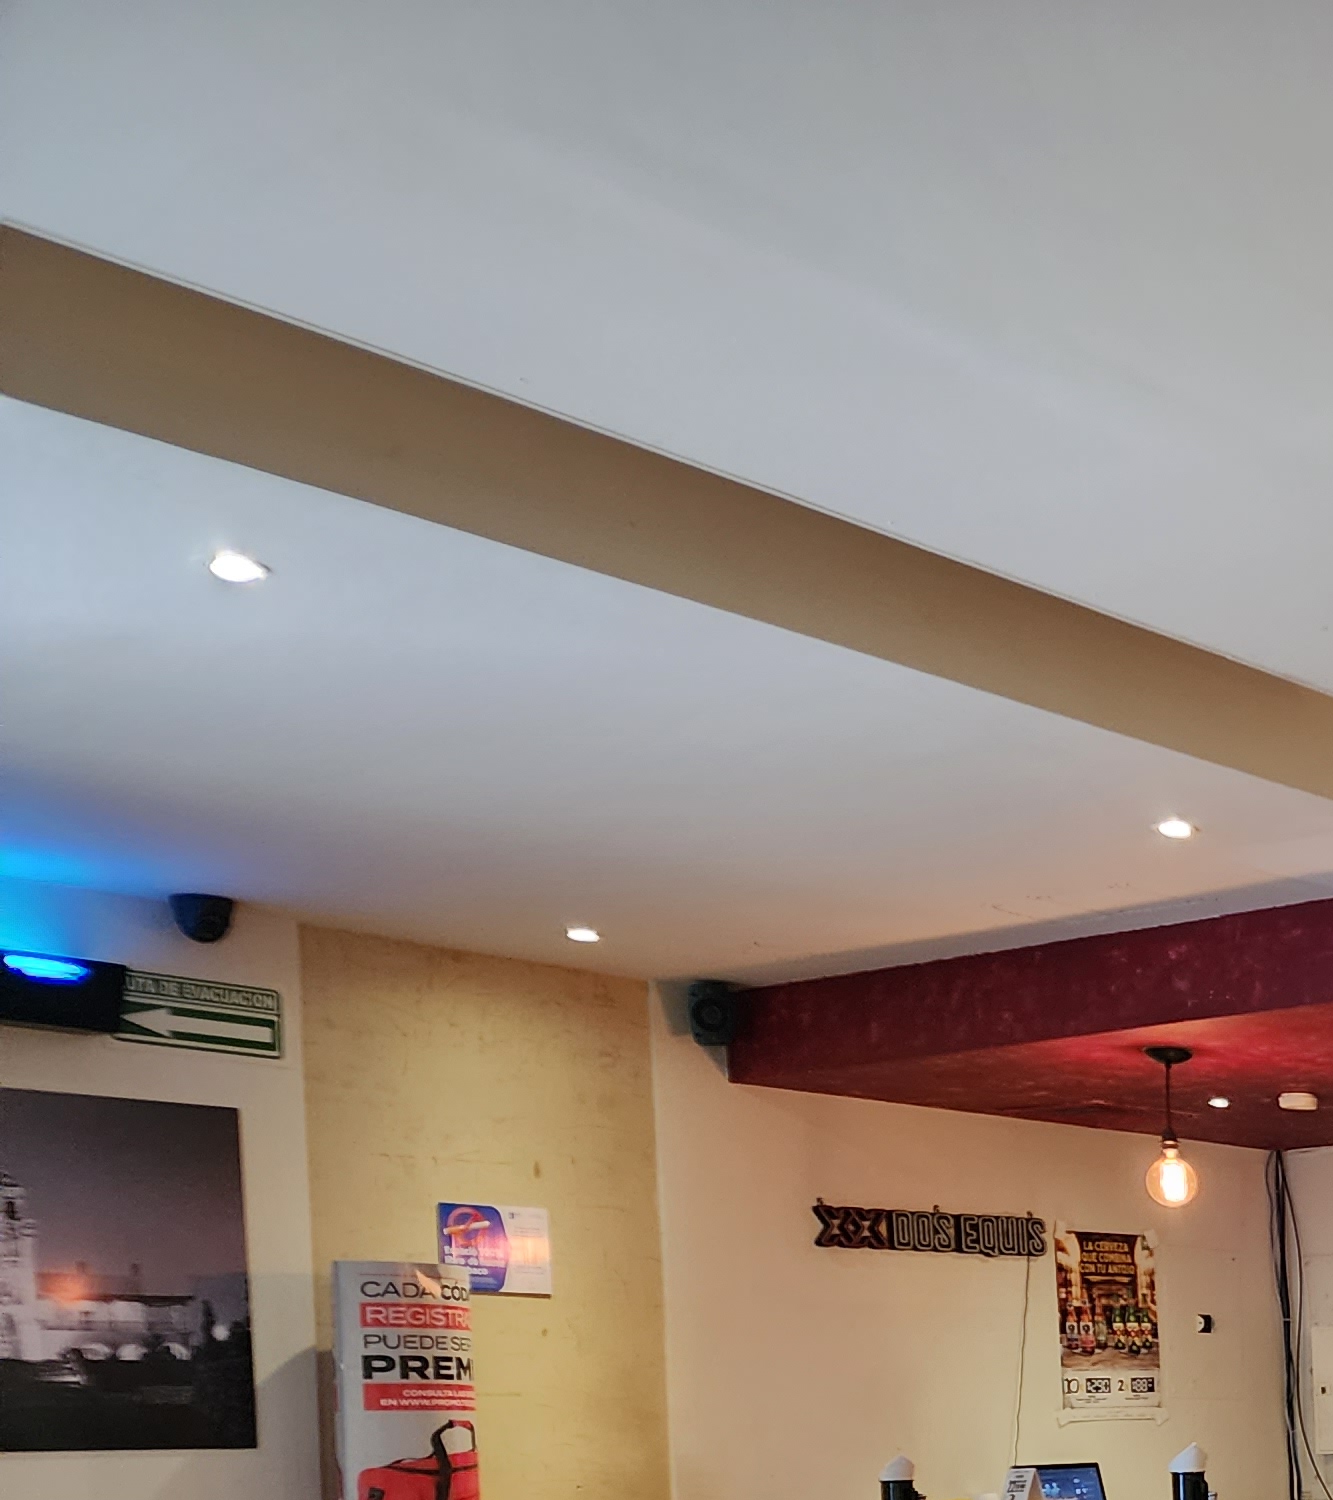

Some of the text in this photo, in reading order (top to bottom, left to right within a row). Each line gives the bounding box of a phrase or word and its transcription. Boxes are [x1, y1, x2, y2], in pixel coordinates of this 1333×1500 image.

[124, 974, 155, 994] UTA
[893, 1211, 954, 1250] DOS
[960, 1215, 1048, 1257] EQUIS
[1083, 1242, 1094, 1251] LA
[360, 1278, 470, 1301] CADA CÓD
[363, 1334, 449, 1350] PUEDE
